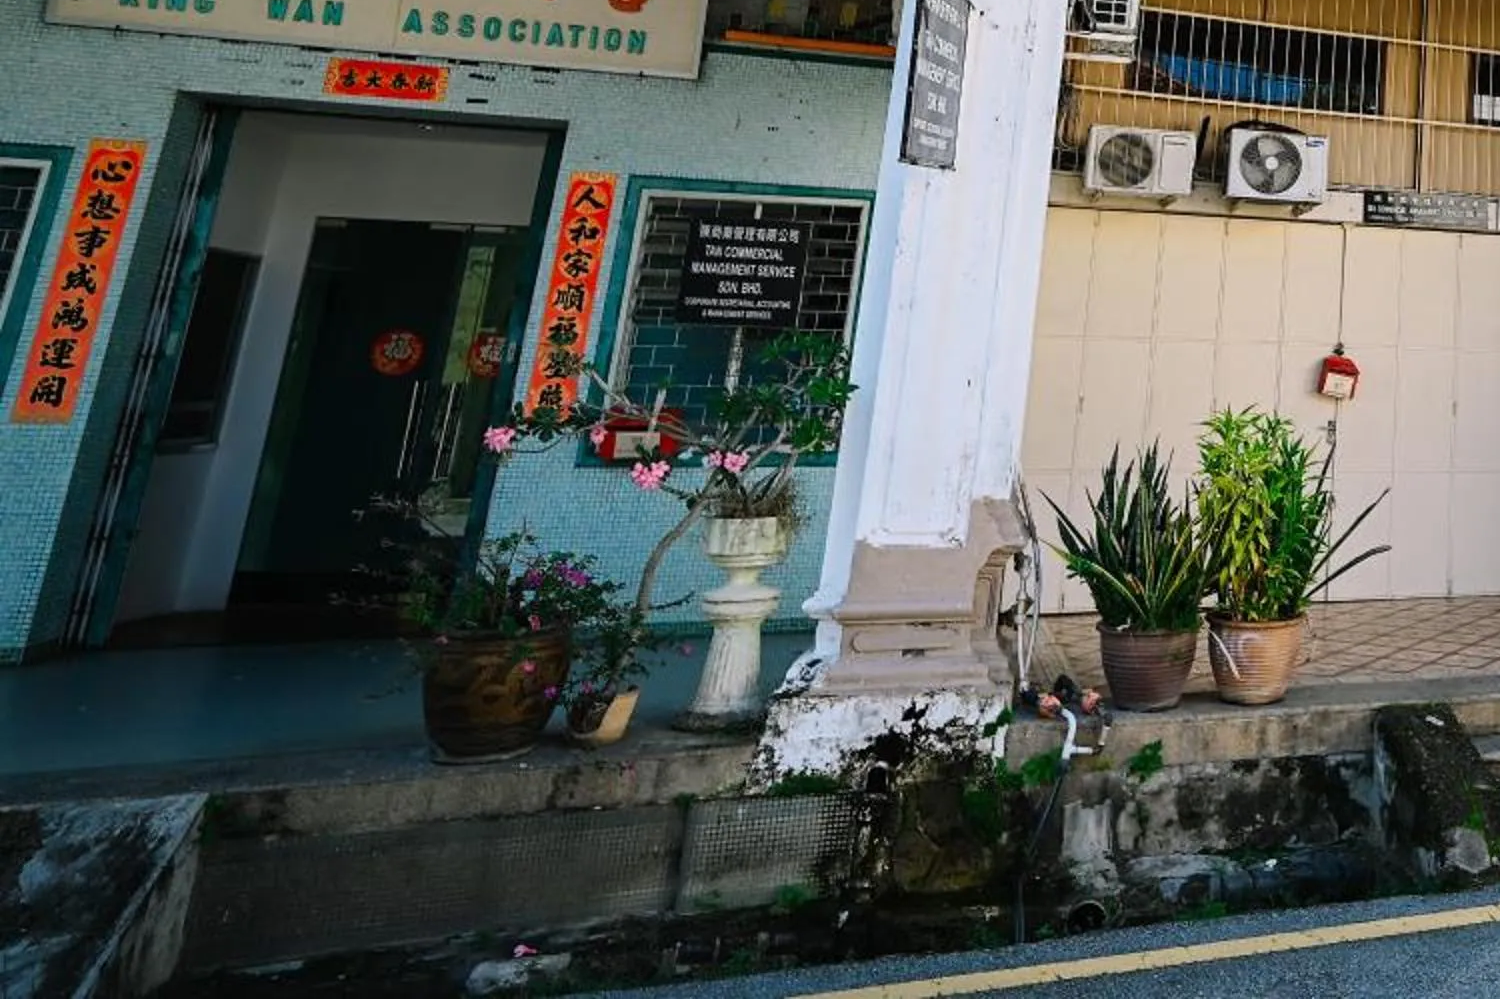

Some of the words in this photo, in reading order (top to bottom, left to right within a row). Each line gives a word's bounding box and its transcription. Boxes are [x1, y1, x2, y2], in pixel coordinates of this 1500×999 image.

[402, 8, 647, 54] ASSOCIATION
[724, 246, 783, 261] COMMERCIAL
[692, 262, 756, 276] MANAGEMENT
[757, 264, 796, 278] SERVICE
